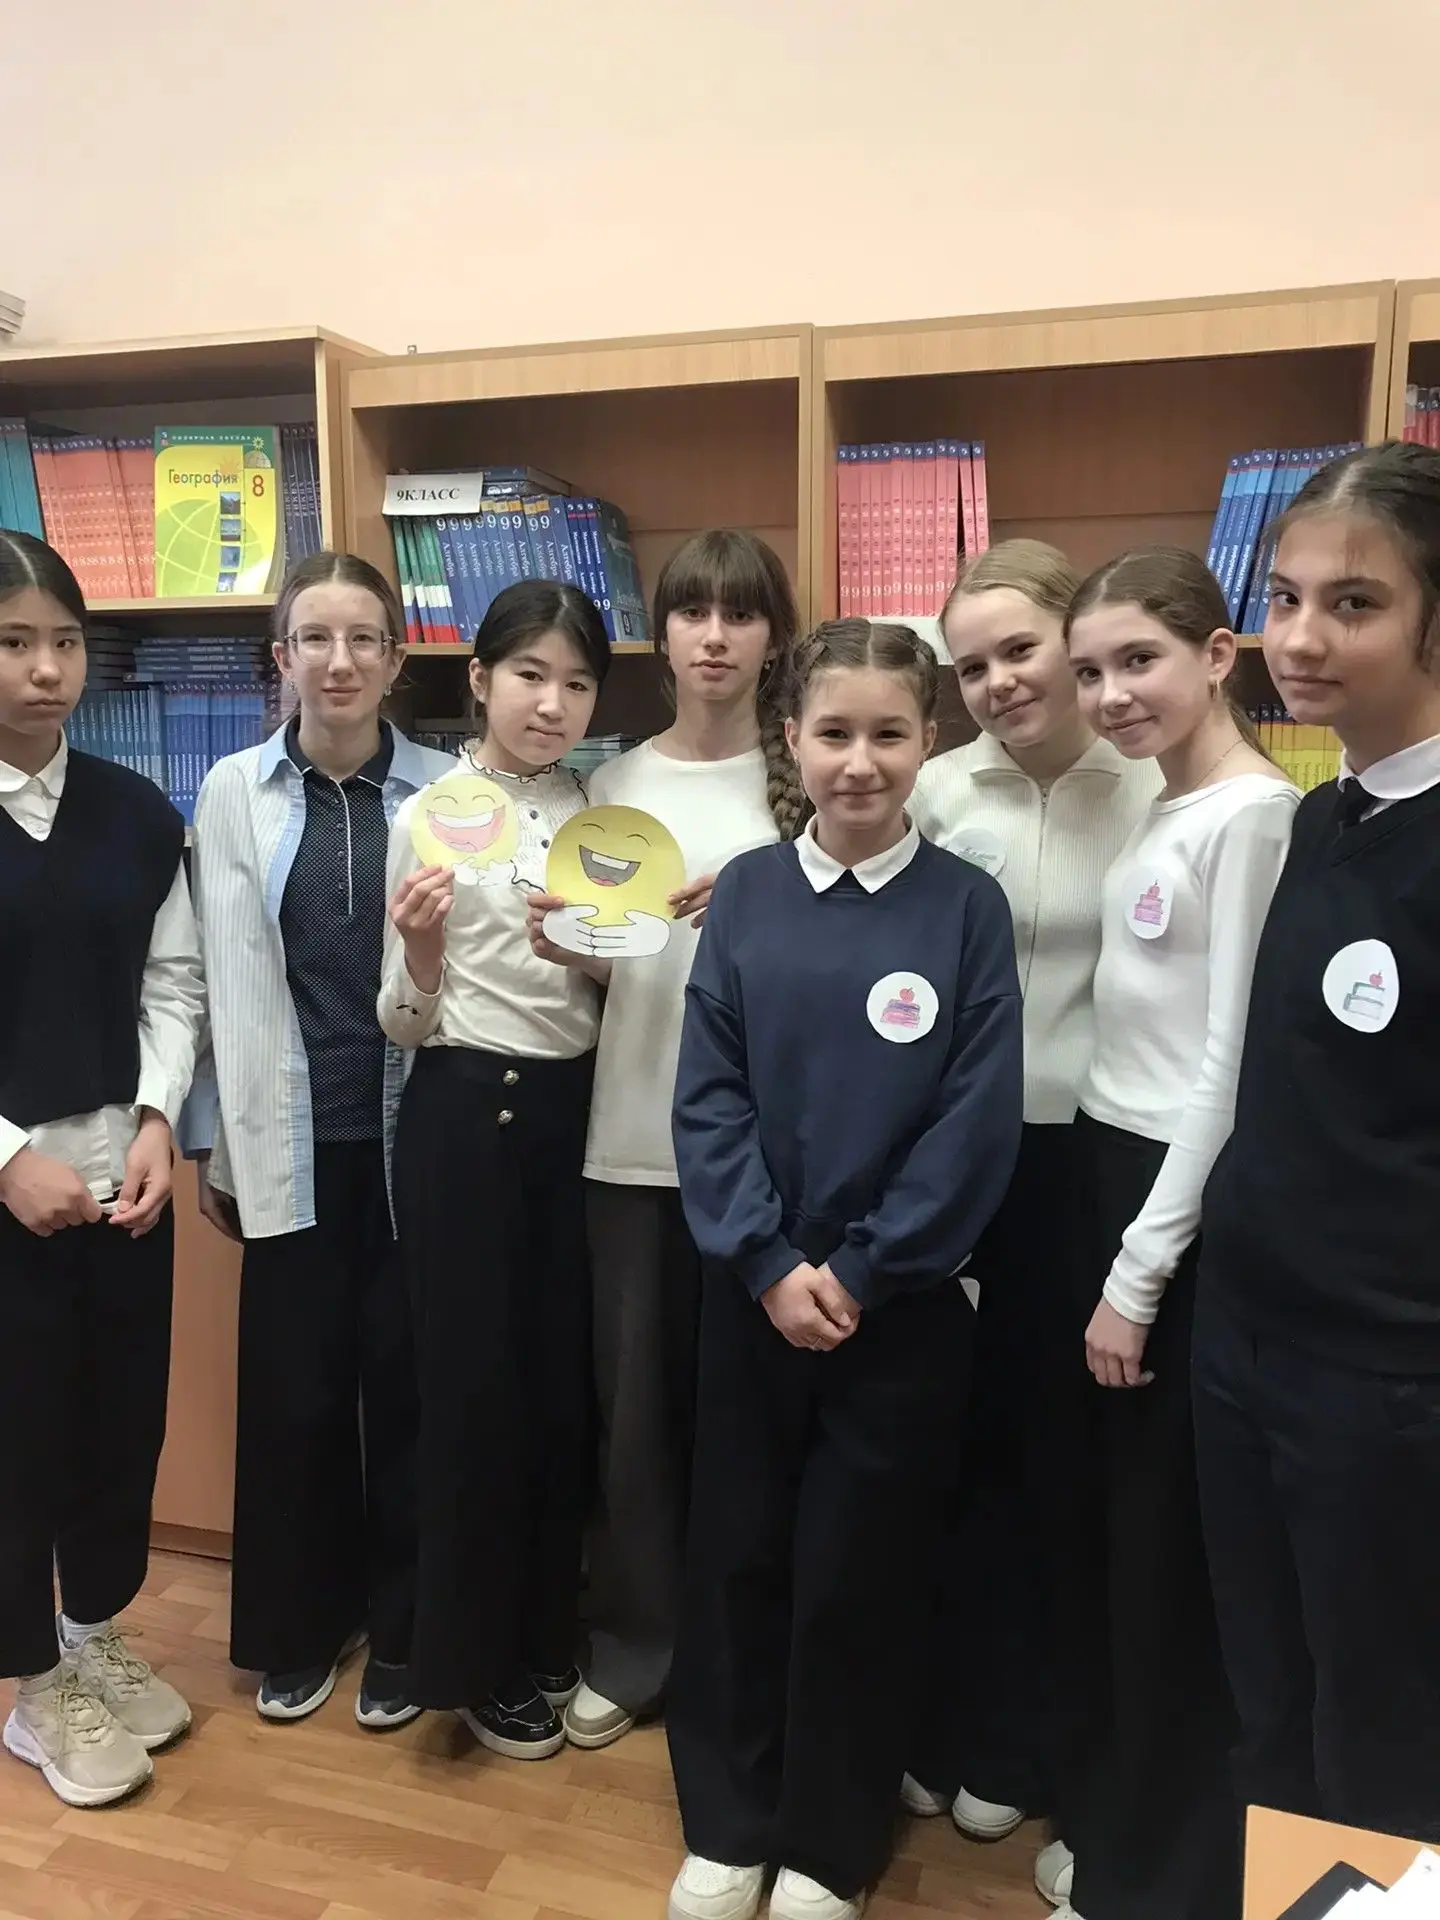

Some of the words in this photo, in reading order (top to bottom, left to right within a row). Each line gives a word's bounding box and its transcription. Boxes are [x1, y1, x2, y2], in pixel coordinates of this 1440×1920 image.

[169, 469, 238, 488] География
[253, 475, 264, 496] 8
[396, 487, 460, 502] 9КЛАСС
[436, 518, 446, 531] 9
[450, 518, 459, 531] 9
[463, 517, 472, 531] 9
[476, 515, 484, 528] 9
[487, 515, 496, 528] 9
[501, 516, 509, 530] 9
[513, 515, 521, 528] 9
[529, 518, 538, 531] 9
[541, 515, 549, 528] 9
[561, 544, 573, 580] Алгебра
[594, 599, 600, 610] 9
[603, 598, 610, 610] 9
